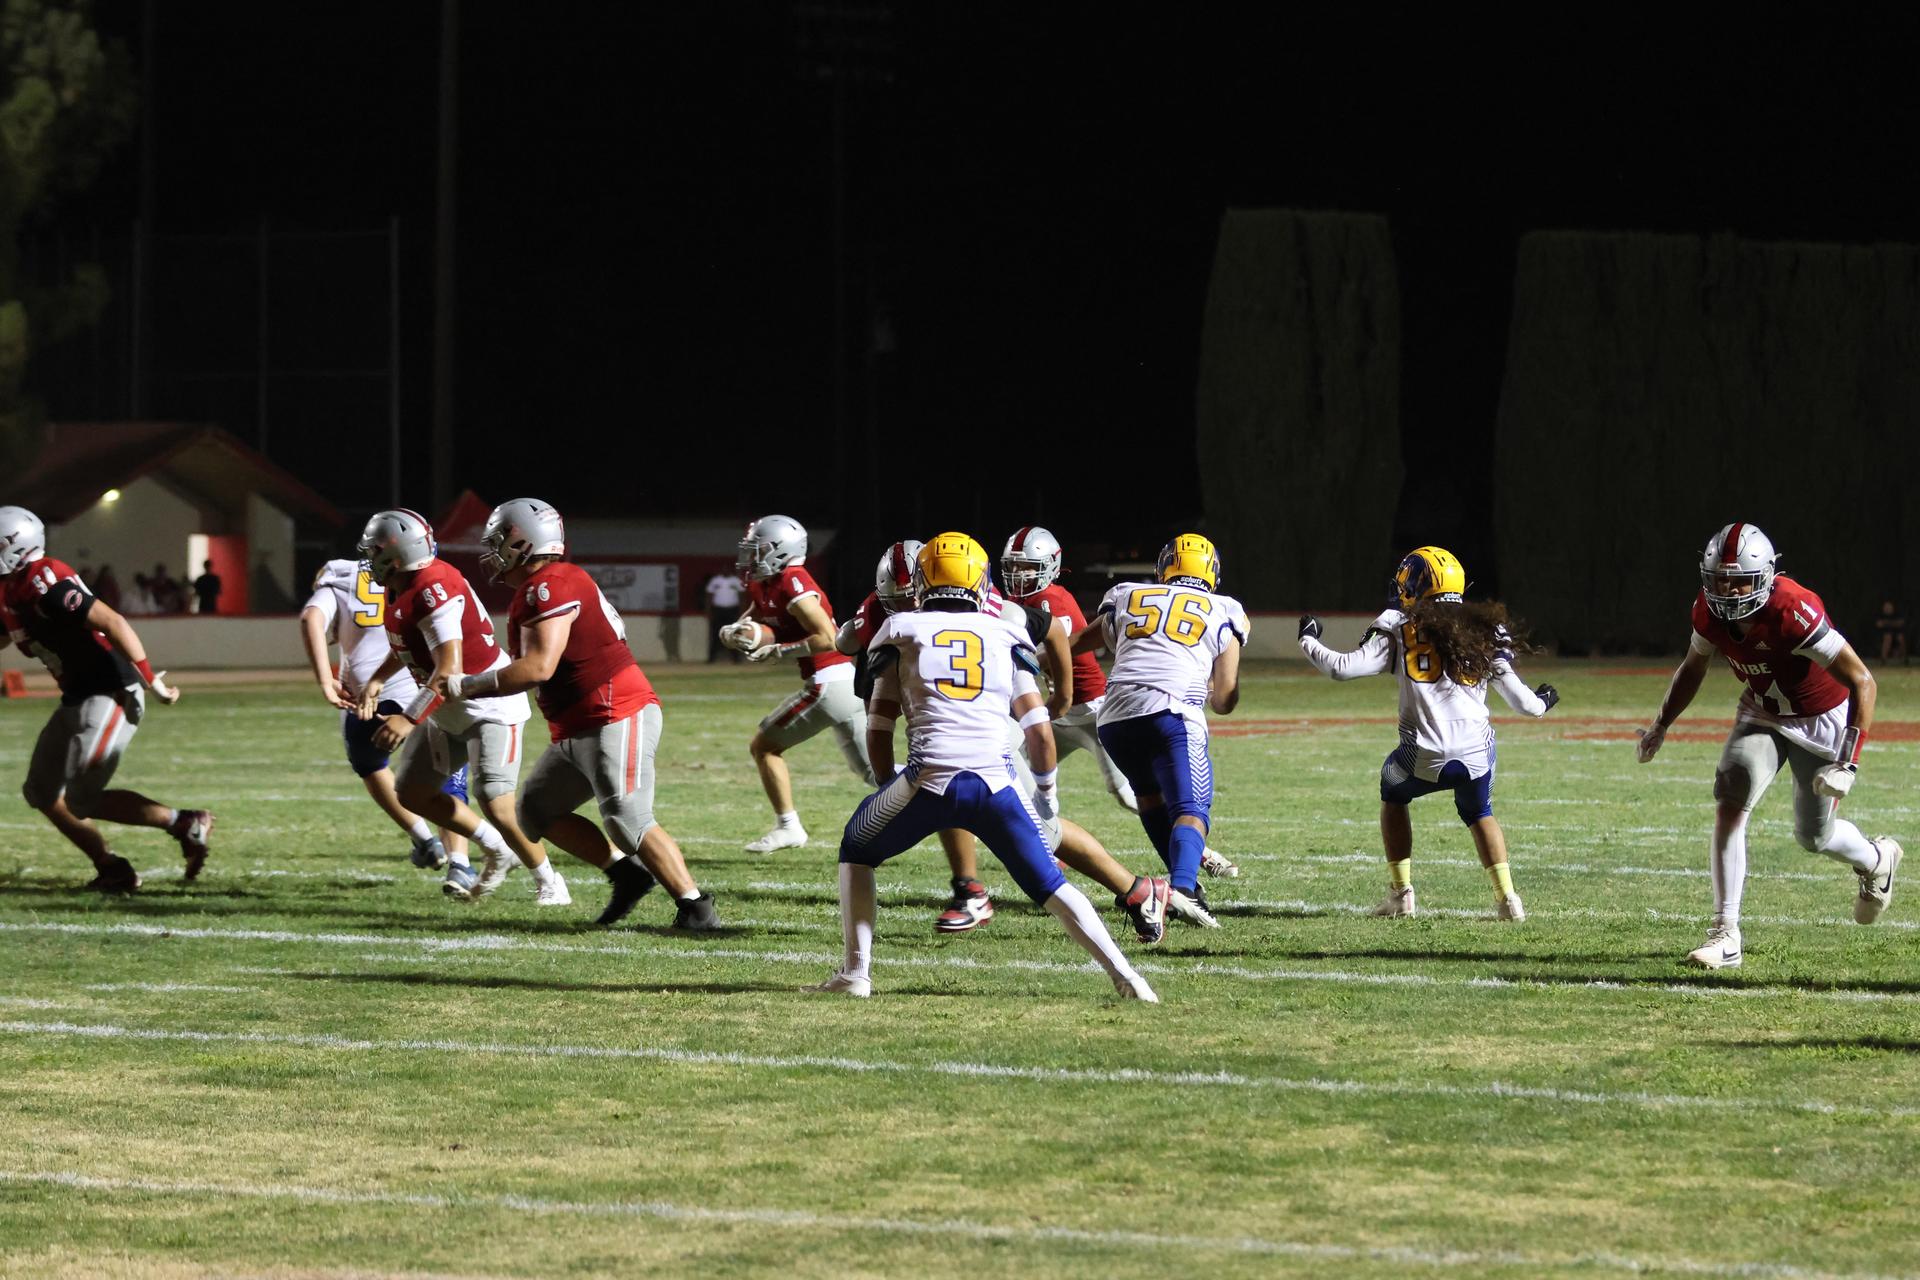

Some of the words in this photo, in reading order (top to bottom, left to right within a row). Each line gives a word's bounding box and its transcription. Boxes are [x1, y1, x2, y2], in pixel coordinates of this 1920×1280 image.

[354, 570, 385, 628] 5
[422, 582, 448, 608] 55
[526, 582, 550, 607] 66
[1793, 600, 1818, 631] 11
[1124, 587, 1213, 648] 56
[932, 629, 985, 702] 3
